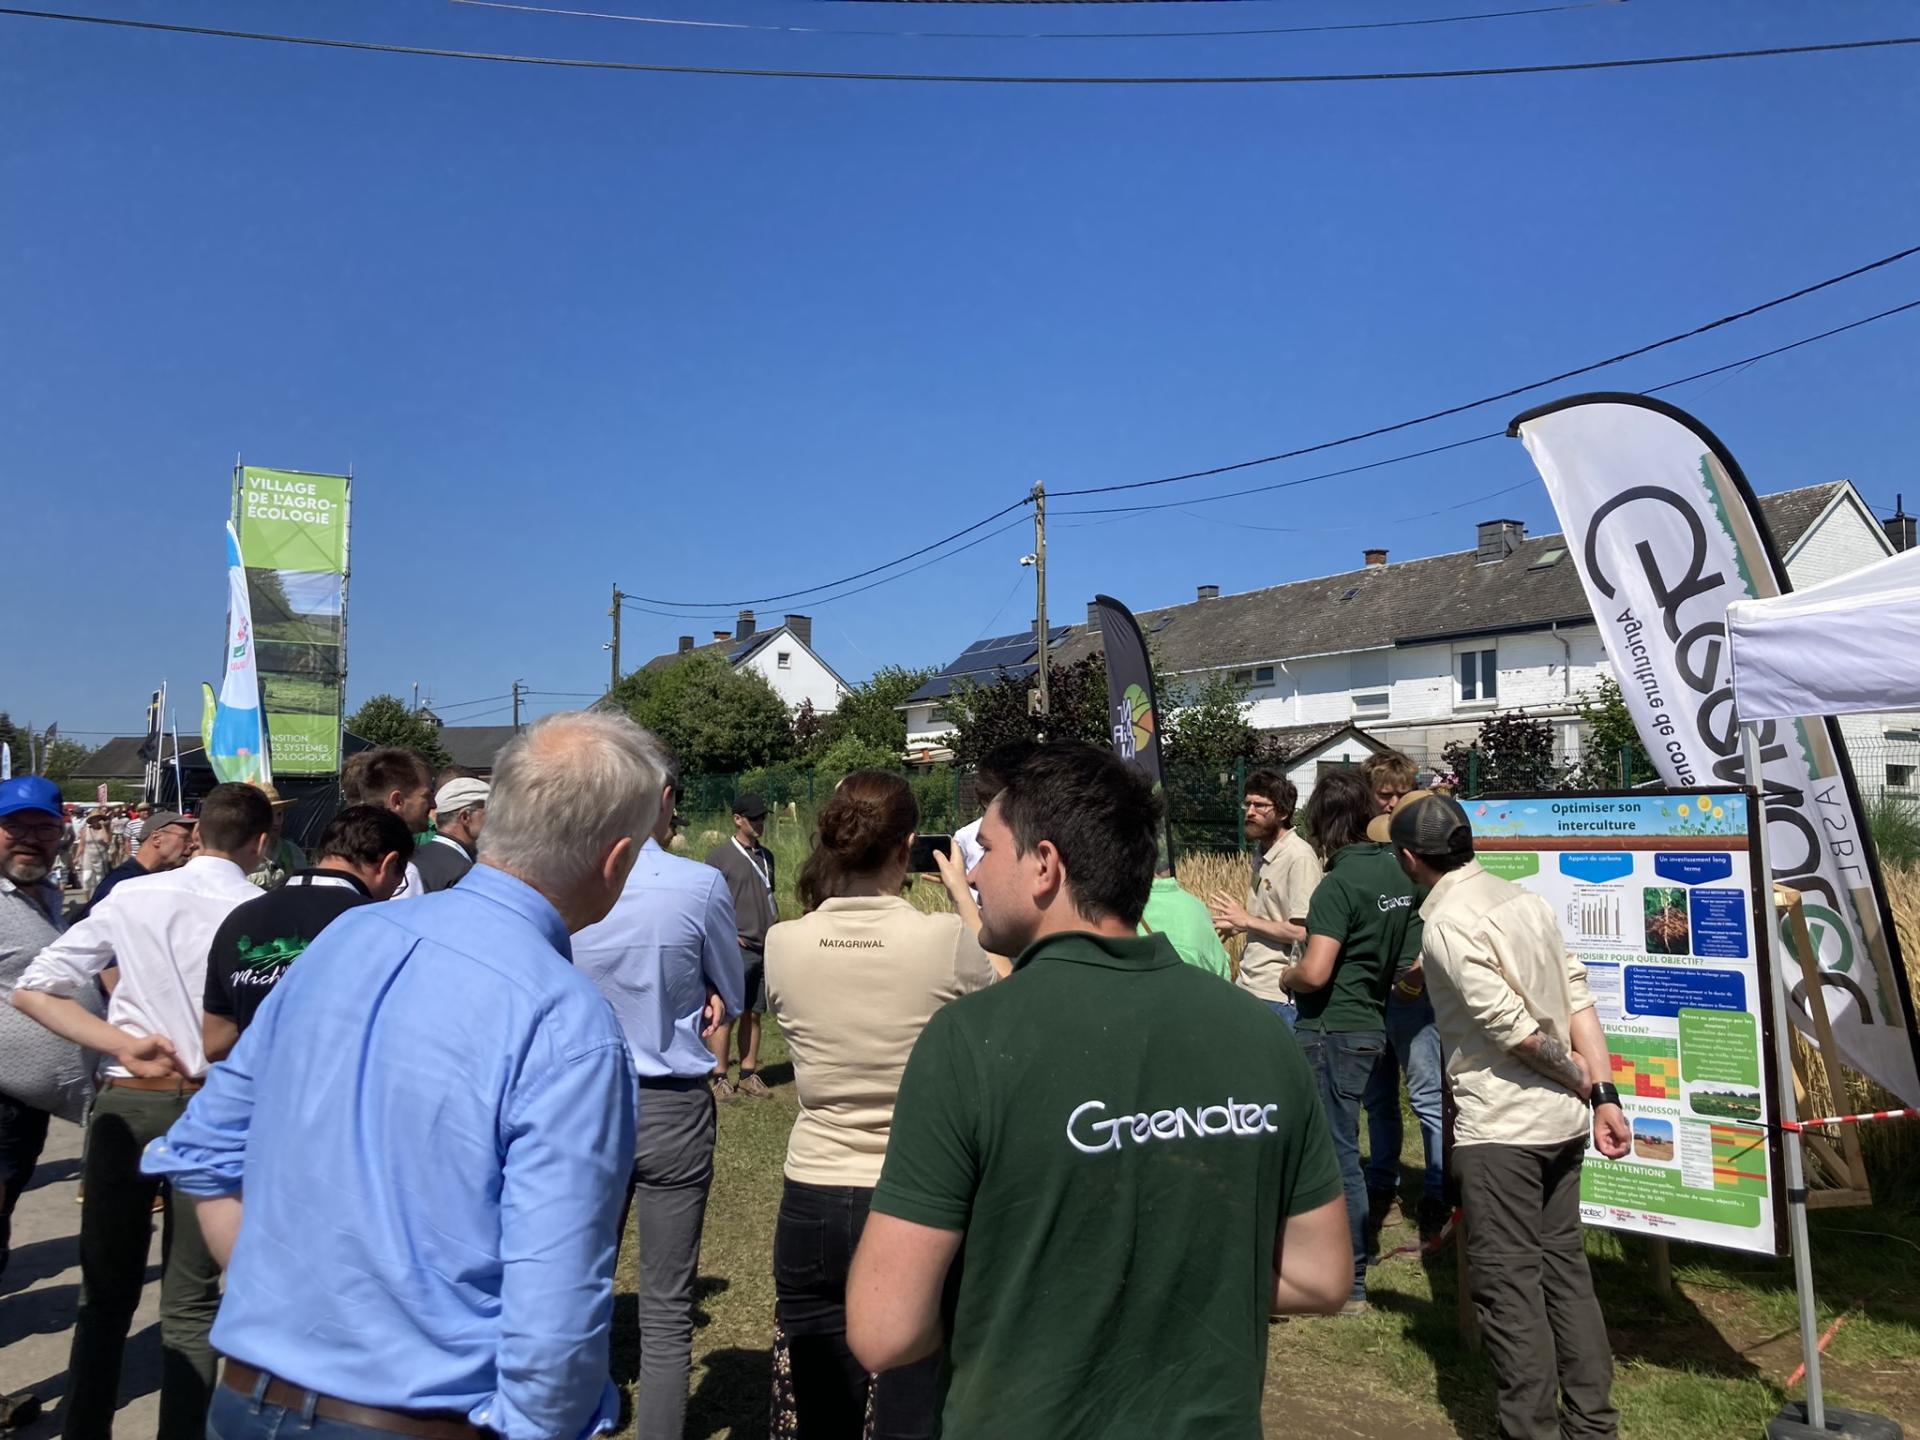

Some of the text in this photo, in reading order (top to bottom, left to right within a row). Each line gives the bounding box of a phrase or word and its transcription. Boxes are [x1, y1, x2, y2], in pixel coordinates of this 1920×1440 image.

[249, 477, 316, 496] VILLAGE
[248, 492, 269, 504] DE
[247, 502, 329, 525] ÉCOLOGIE
[271, 733, 309, 742] NSITION
[272, 743, 281, 751] ES
[272, 752, 332, 761] COLOGIQUES
[1551, 802, 1641, 816] Optimiser son
[1558, 819, 1636, 831] interculture
[1577, 952, 1704, 966] HOISIR? POUR QUEL OBJECTIF?
[1602, 1023, 1649, 1034] TRUCTION?
[1638, 1105, 1680, 1116] MOISSON
[1583, 1160, 1666, 1178] INTS D'ATTENTIONS
